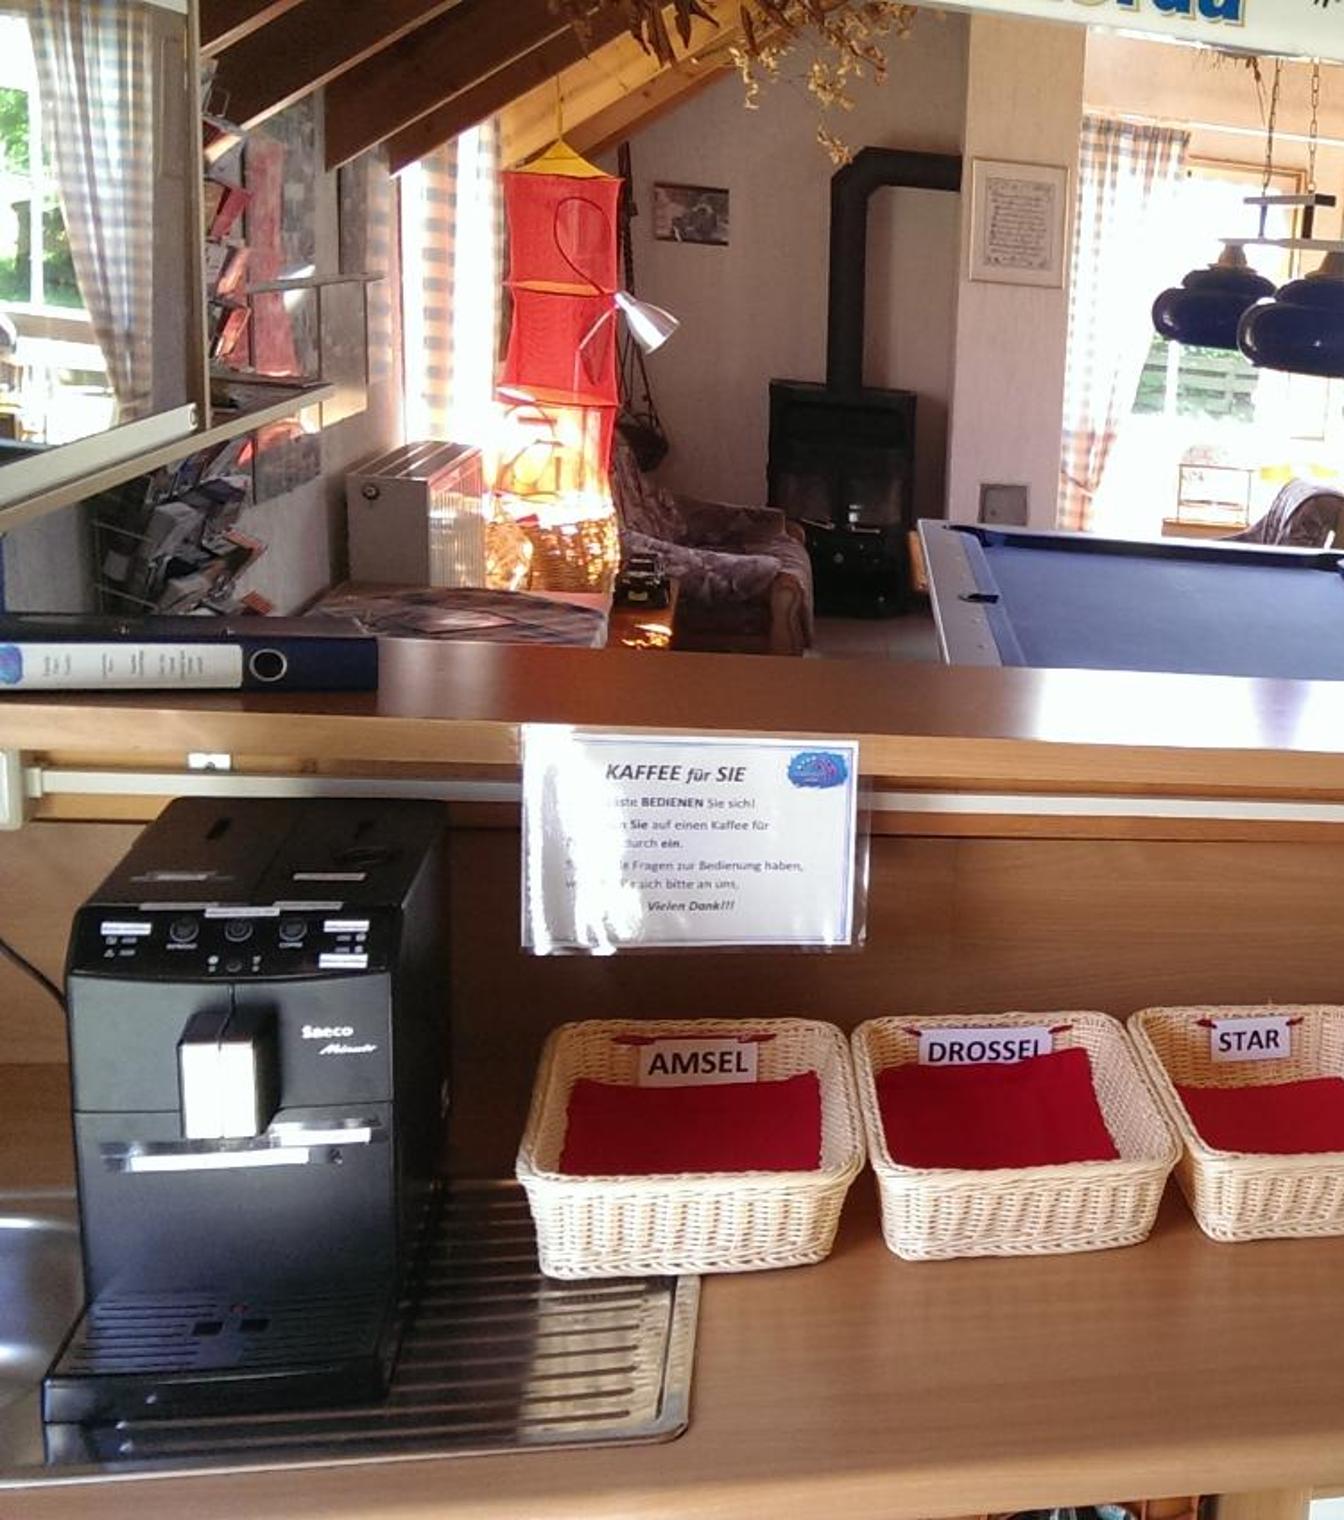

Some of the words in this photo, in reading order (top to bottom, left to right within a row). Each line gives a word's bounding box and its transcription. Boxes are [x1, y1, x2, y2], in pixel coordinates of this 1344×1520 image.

[606, 763, 683, 781] KAFFEE
[686, 767, 711, 784] für
[715, 766, 746, 782] SIE
[641, 797, 704, 809] BEDIENEN
[707, 799, 725, 809] Sie
[728, 798, 756, 809] sich!
[630, 818, 648, 830] Sie
[652, 818, 671, 830] auf
[674, 820, 708, 831] einen
[711, 820, 749, 831] Kaffee
[752, 820, 770, 831] für
[632, 859, 674, 873] Fragen
[677, 862, 694, 871] zur
[699, 860, 762, 873] Bedienung
[666, 877, 693, 889] bitte
[697, 880, 712, 890] an
[648, 900, 685, 912] Vielen
[689, 900, 735, 912] Dank!!!
[301, 1024, 354, 1039] Saeco
[1218, 1028, 1280, 1053] STAR
[647, 1049, 750, 1077] AMSEL
